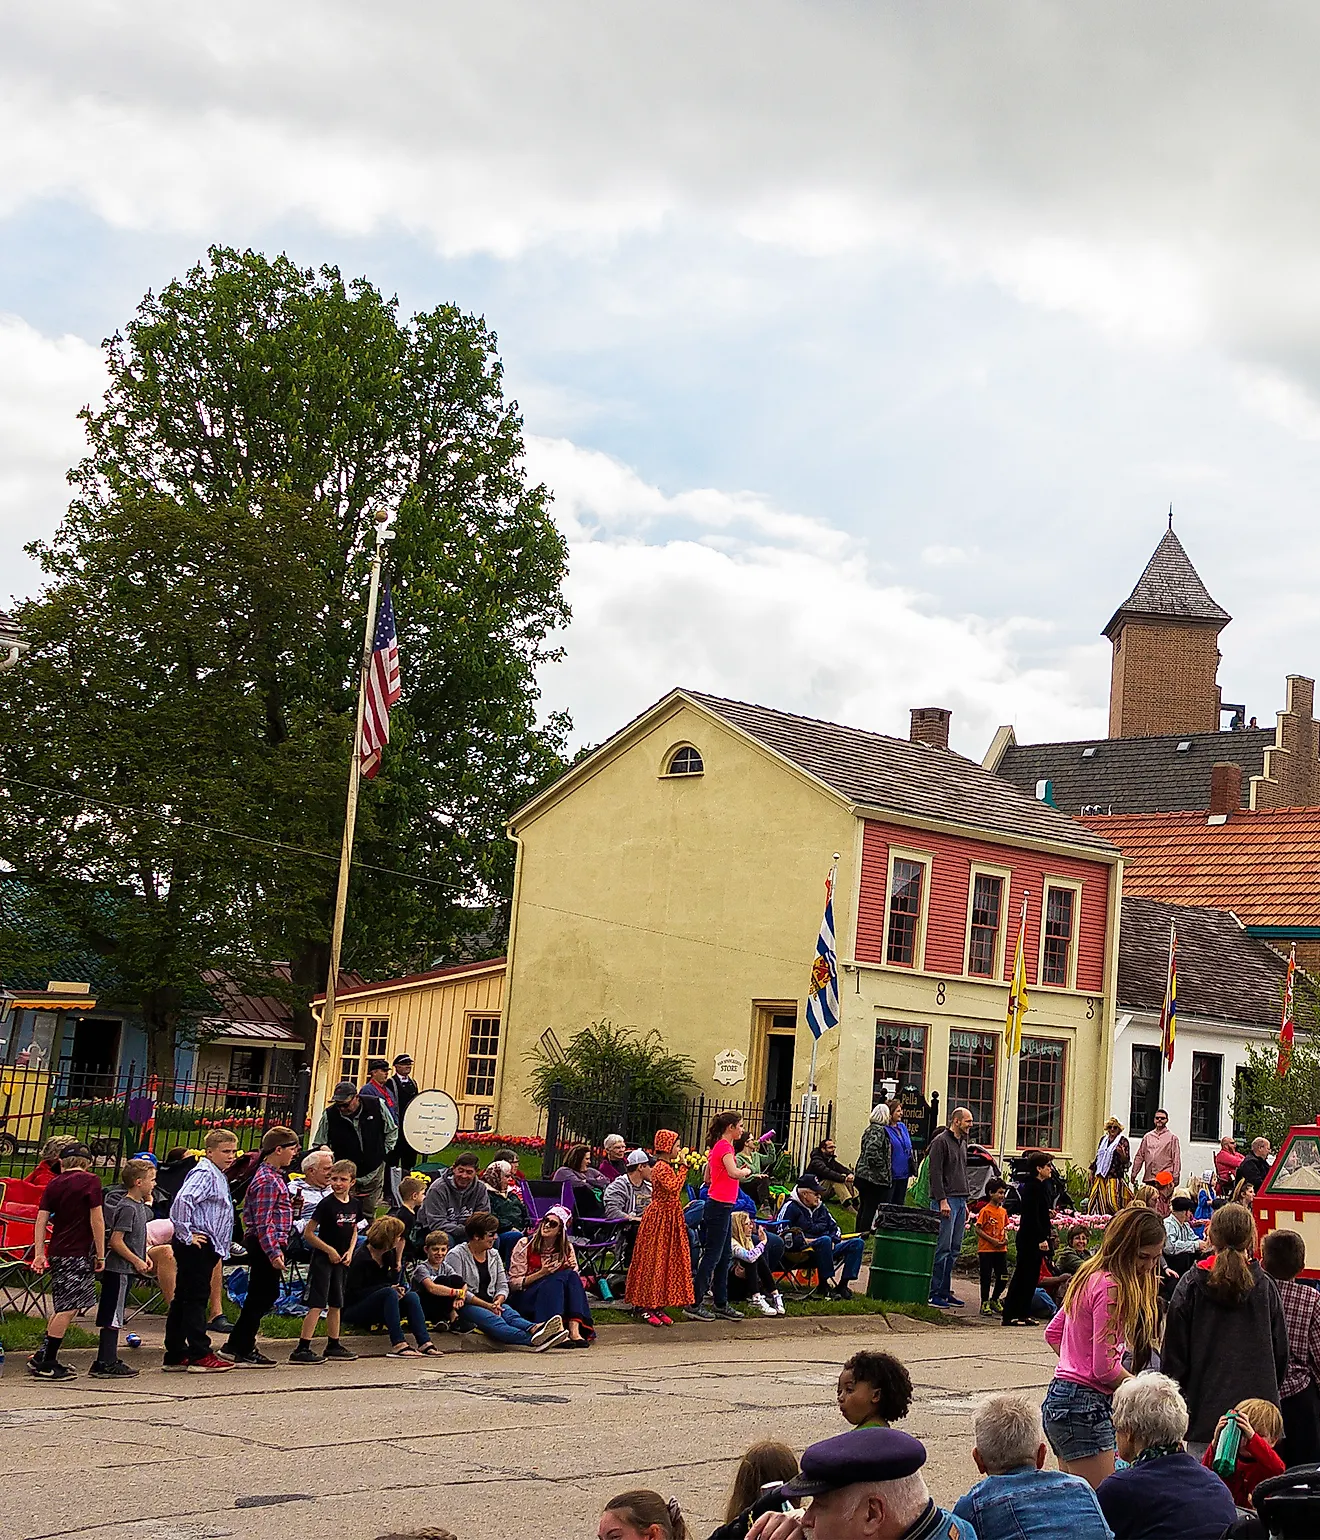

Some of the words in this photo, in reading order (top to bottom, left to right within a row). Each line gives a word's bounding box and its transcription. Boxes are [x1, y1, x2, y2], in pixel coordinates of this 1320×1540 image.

[936, 981, 946, 1006] 8
[1085, 997, 1094, 1020] 3
[720, 1064, 738, 1073] STORE
[901, 1093, 918, 1106] Pella
[903, 1106, 925, 1119] torical
